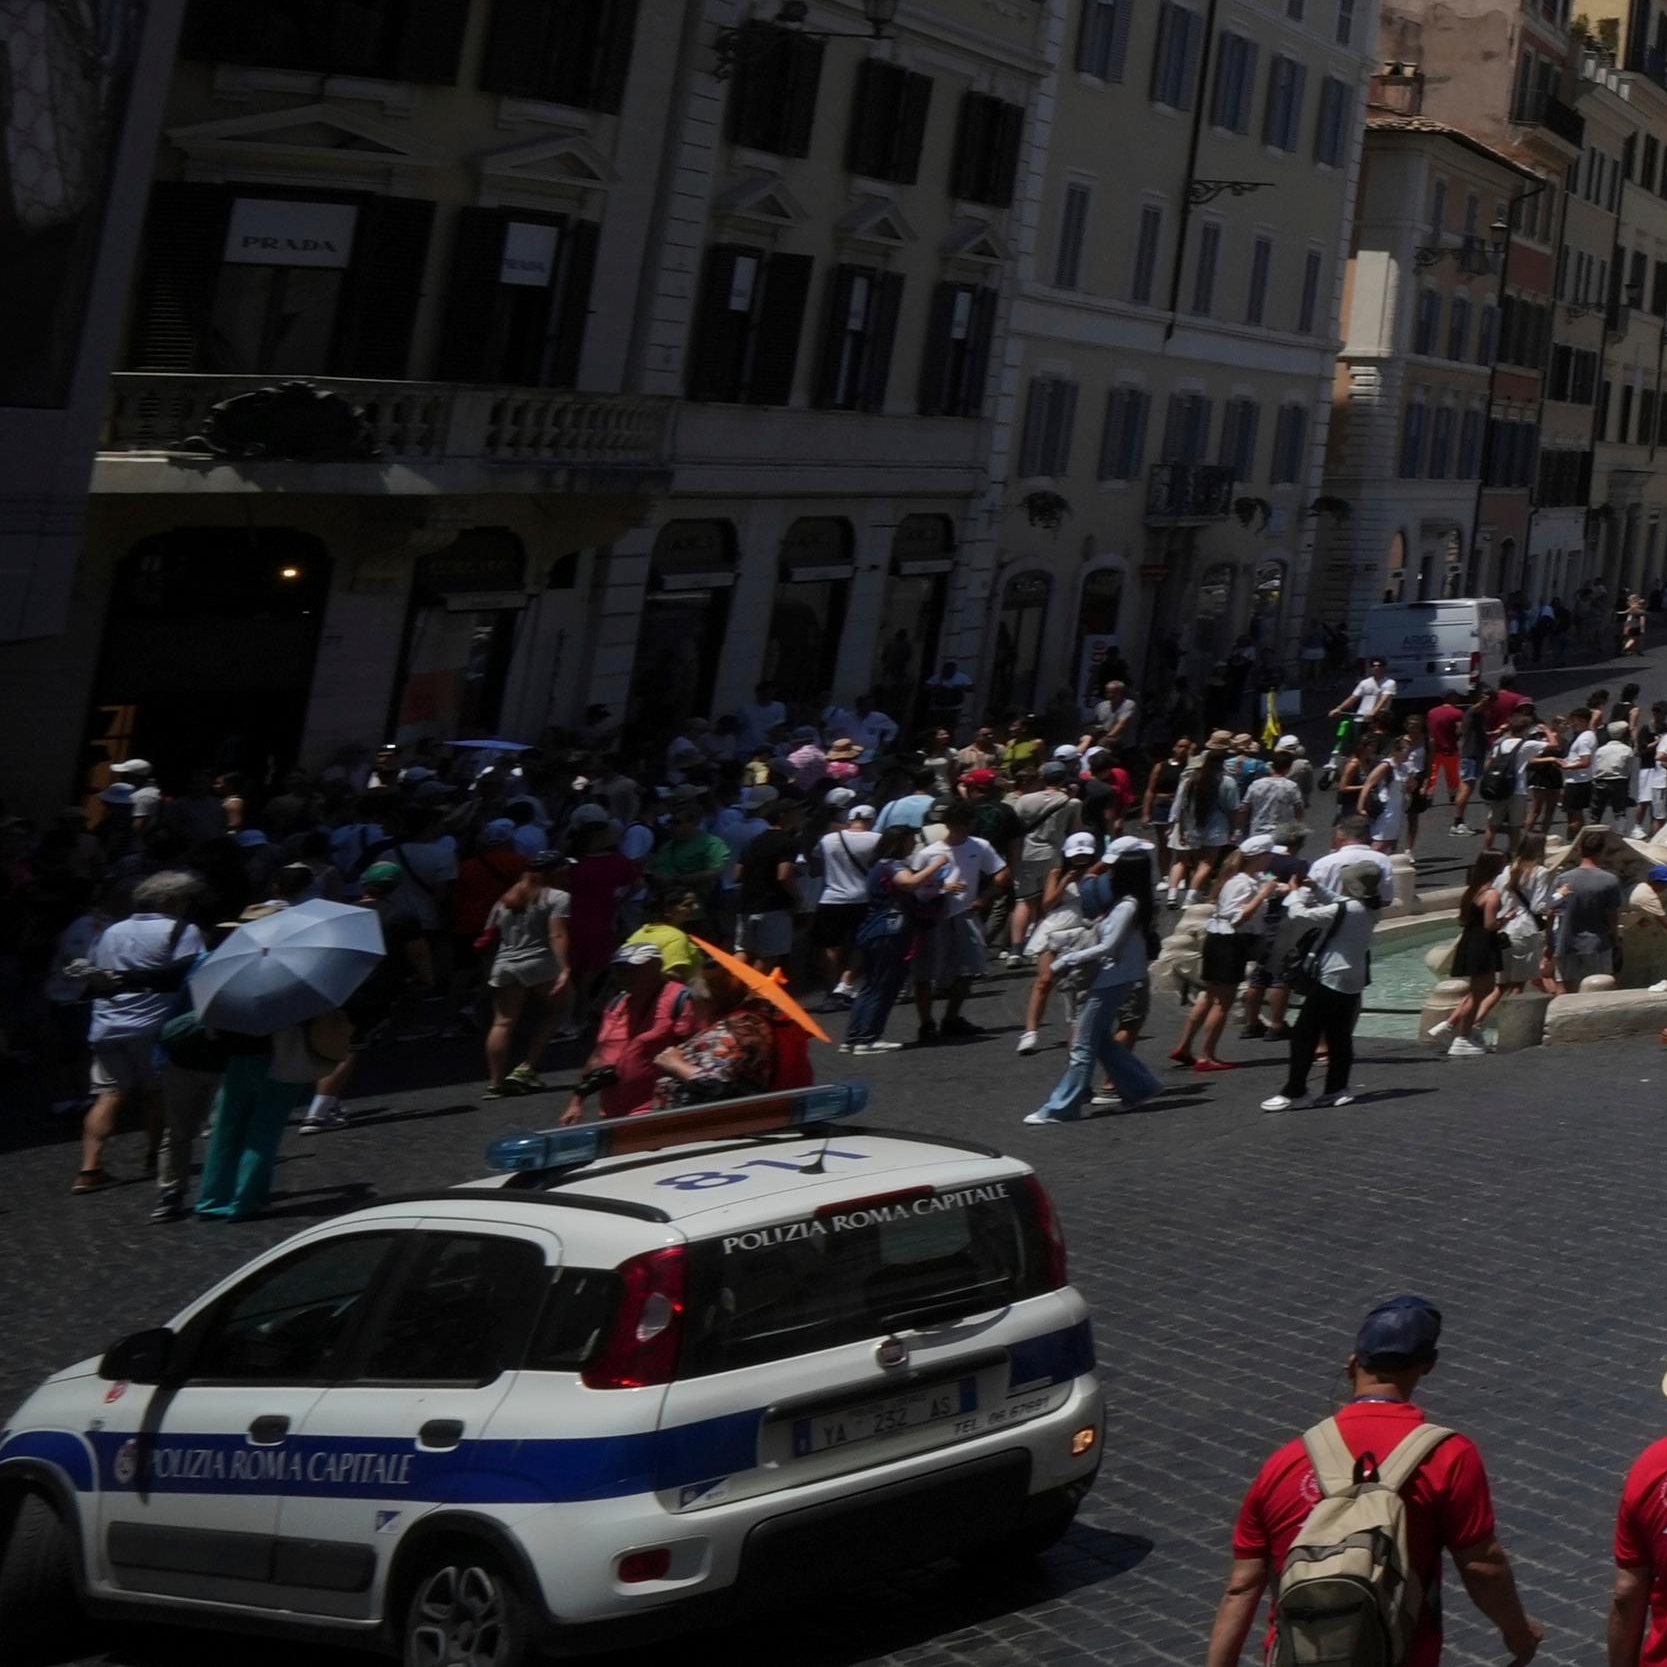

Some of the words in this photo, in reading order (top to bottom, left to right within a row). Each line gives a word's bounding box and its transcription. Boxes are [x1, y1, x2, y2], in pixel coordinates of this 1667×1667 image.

[241, 234, 338, 254] PRADA
[654, 1148, 873, 1192] 811
[722, 1220, 828, 1255] POLIZIA
[831, 1202, 910, 1234] ROMA
[911, 1182, 1011, 1217] CAPITALE
[150, 1447, 226, 1480] POLIZIA
[229, 1449, 302, 1482] ROMA
[307, 1451, 416, 1485] CAPITALE
